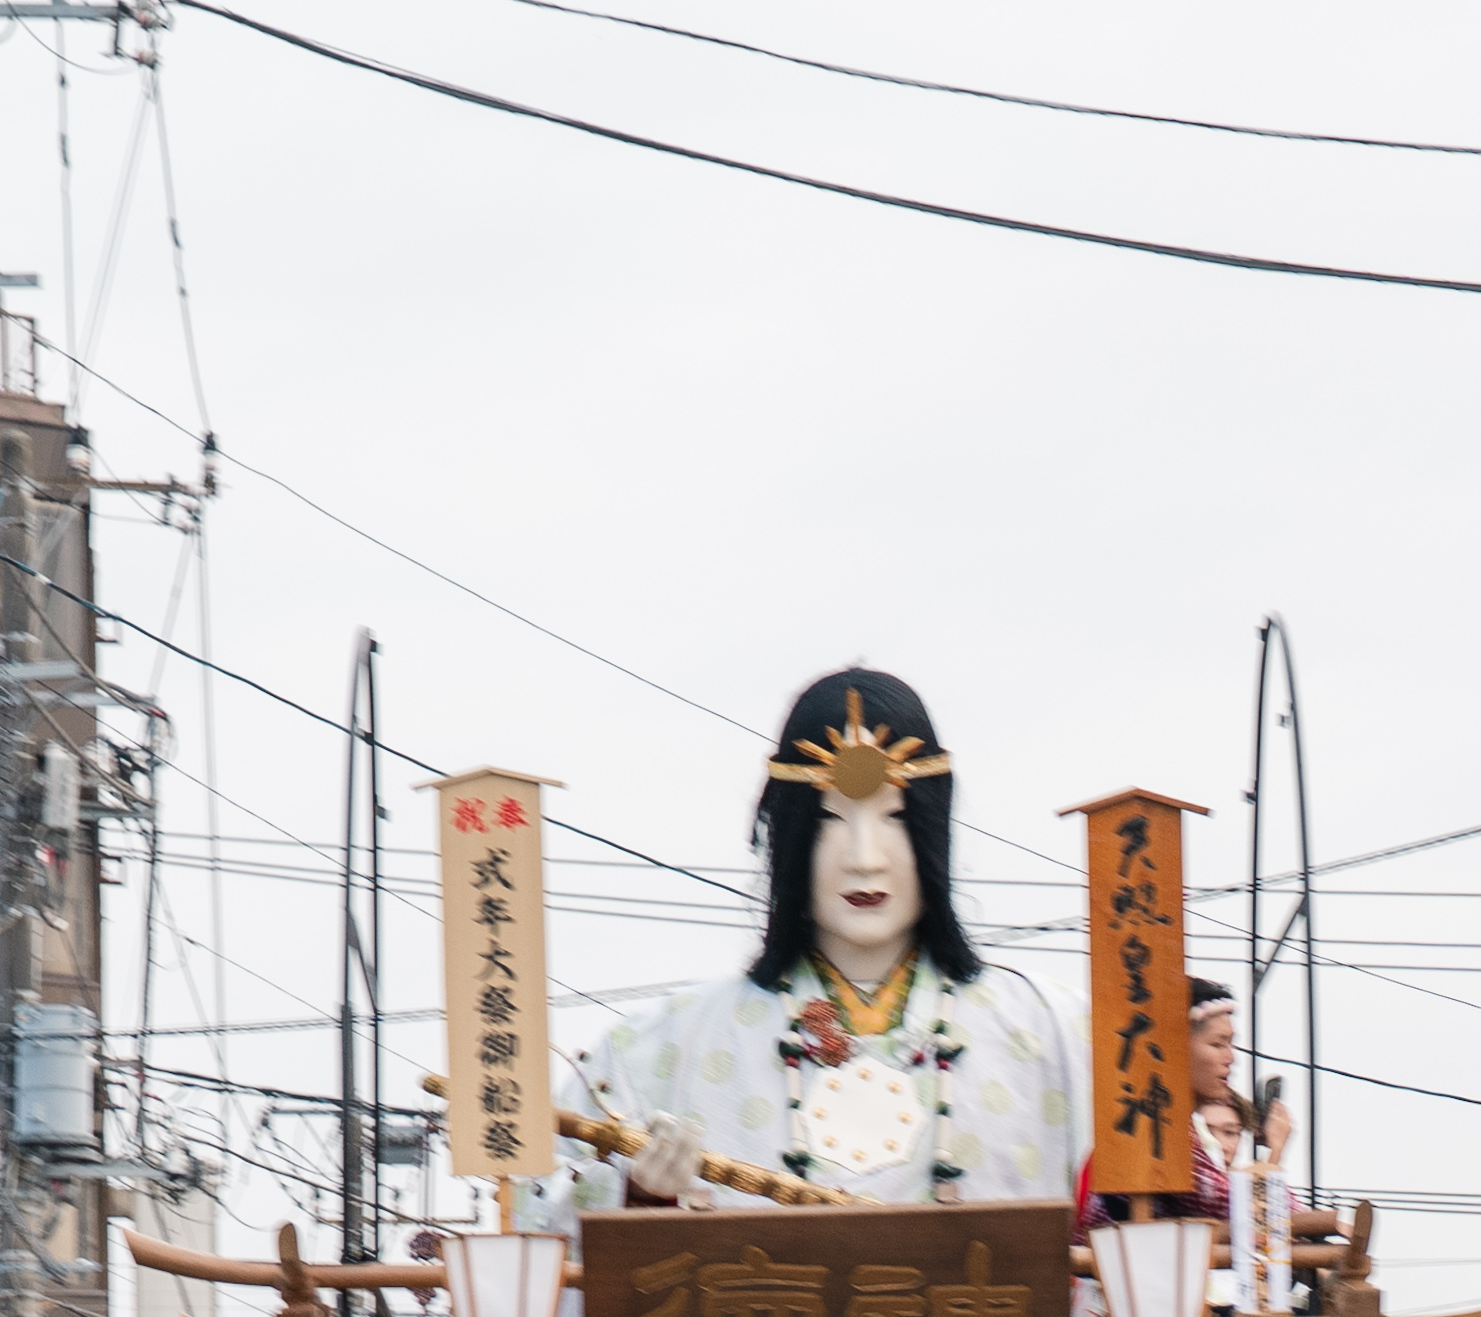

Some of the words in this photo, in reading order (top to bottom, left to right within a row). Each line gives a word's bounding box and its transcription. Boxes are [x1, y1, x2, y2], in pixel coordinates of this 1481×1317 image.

[469, 846, 526, 1162] 式年大祭御船祭
[1109, 814, 1175, 1162] 天照皇大神
